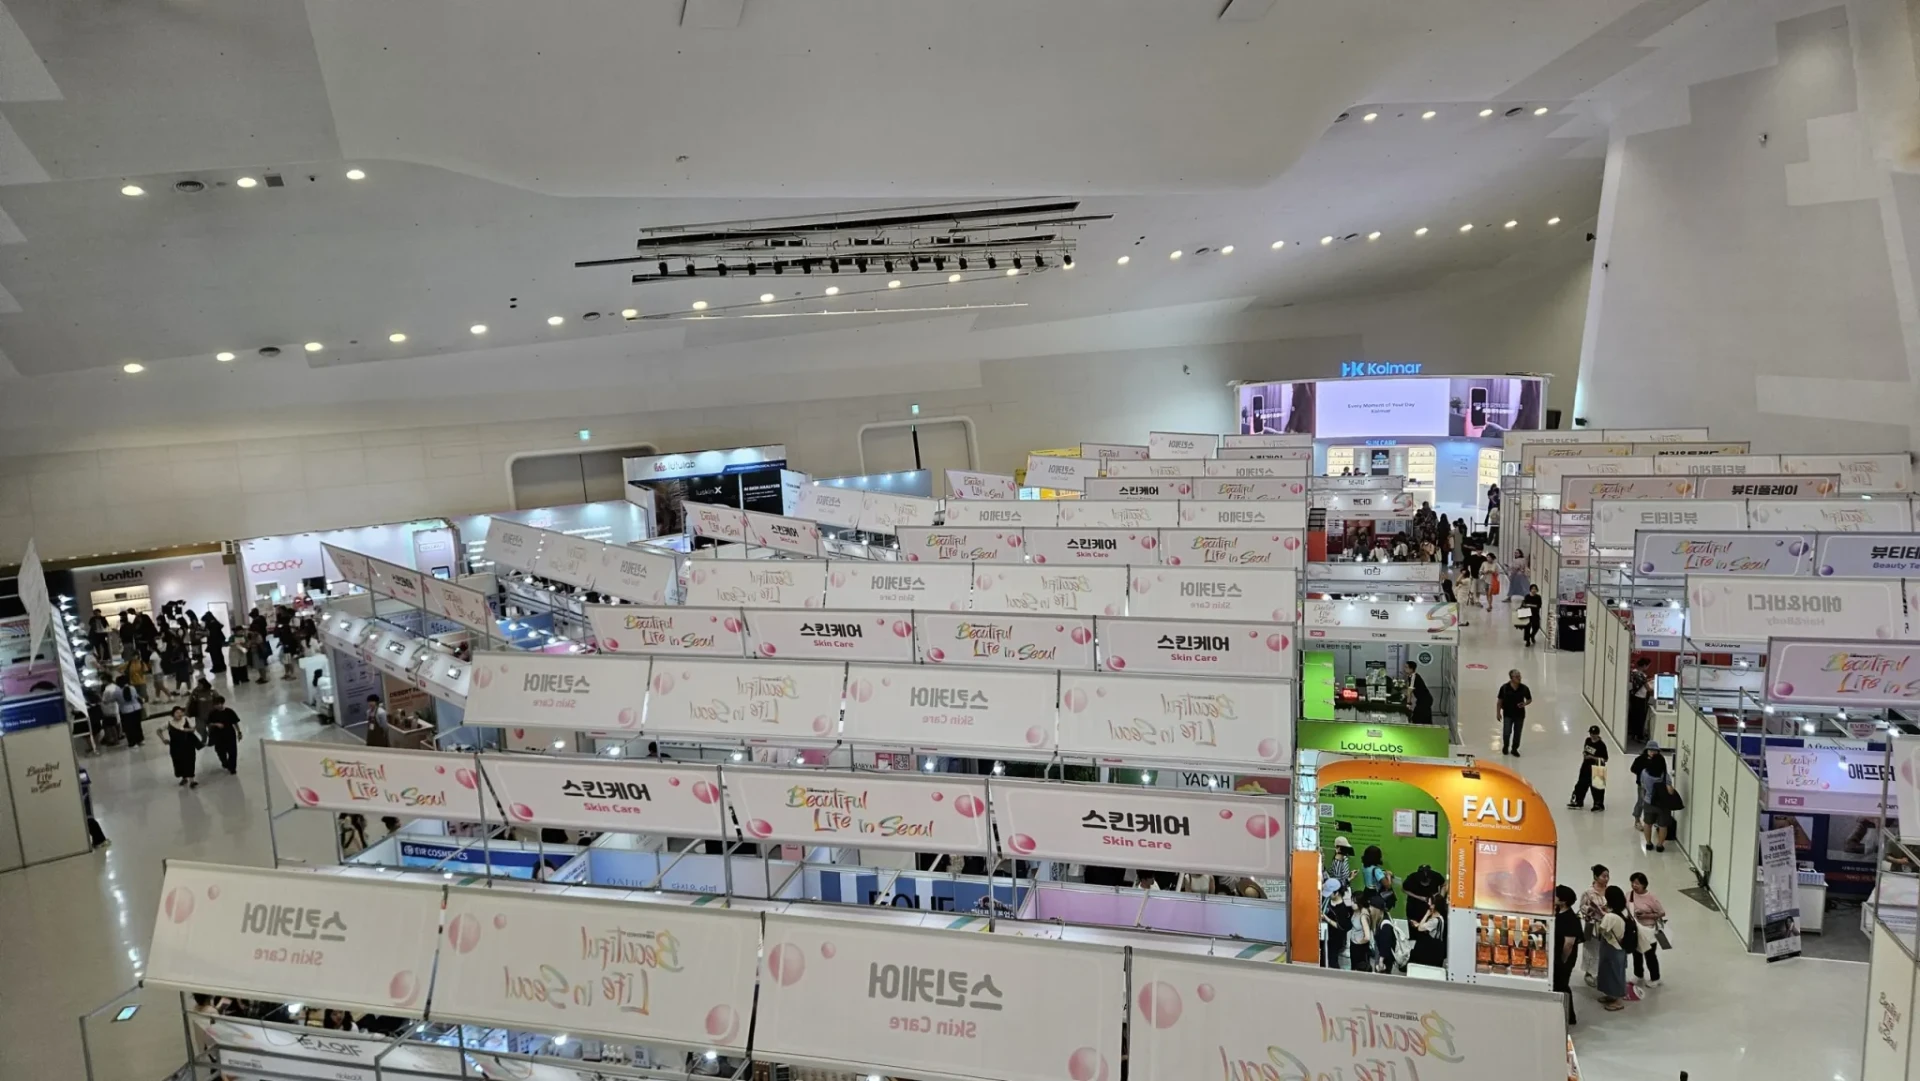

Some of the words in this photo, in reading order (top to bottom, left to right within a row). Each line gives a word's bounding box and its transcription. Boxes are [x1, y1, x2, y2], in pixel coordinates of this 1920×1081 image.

[1367, 361, 1422, 375] Kolmar
[1118, 486, 1159, 496] 스킨케어
[1731, 484, 1798, 496] 뷰티플레이
[925, 533, 967, 547] Beautiful
[1066, 538, 1117, 550] 스킨케어
[1190, 535, 1239, 551] Beautiful
[1671, 540, 1732, 556] Beautiful
[938, 546, 958, 560] Life
[960, 550, 970, 560] in
[970, 547, 998, 560] Seoul
[1203, 549, 1227, 563] Life
[1228, 553, 1238, 564] in
[1239, 550, 1272, 565] Seoul
[251, 558, 304, 574] COCORY
[1684, 555, 1713, 570] Life
[1715, 557, 1726, 570] in
[1728, 558, 1770, 573] Seoul
[1872, 562, 1906, 571] Beauty
[100, 568, 143, 583] Lonitin
[623, 613, 674, 631] Beautiful
[1370, 608, 1390, 620] 엑솜
[642, 629, 666, 646] Life
[668, 635, 681, 647] in
[681, 634, 715, 648] Seoul
[799, 622, 863, 639] 스킨케어
[955, 621, 1013, 643] Beautiful
[813, 639, 833, 648] Skin
[834, 640, 854, 649] Care
[973, 639, 1000, 657] Life
[1004, 646, 1016, 658] in
[1017, 644, 1056, 661] Seoul
[1157, 635, 1230, 652] 스킨케어
[1170, 653, 1192, 662] Skin
[1195, 654, 1218, 663] Care
[1820, 652, 1910, 676] Beautiful
[1836, 672, 1881, 693] Life
[1883, 678, 1900, 694] in
[1341, 740, 1404, 753] LoudLabs
[320, 757, 387, 782] Beautiful
[347, 779, 379, 801] Life
[383, 790, 400, 804] in
[401, 786, 447, 807] Seoul
[561, 778, 652, 802] 스킨케어
[785, 785, 868, 809] Beautiful
[583, 802, 608, 813] Skin
[611, 804, 641, 815] Care
[1463, 795, 1524, 823] FAU
[812, 808, 852, 832] Life
[858, 819, 875, 833] in
[877, 814, 935, 838] Seoul
[1081, 809, 1191, 837] 스킨케어
[1101, 835, 1134, 848] Skin
[1136, 838, 1172, 850] Care
[1479, 843, 1498, 852] FAU
[1458, 848, 1467, 899] www.fau.co.kr
